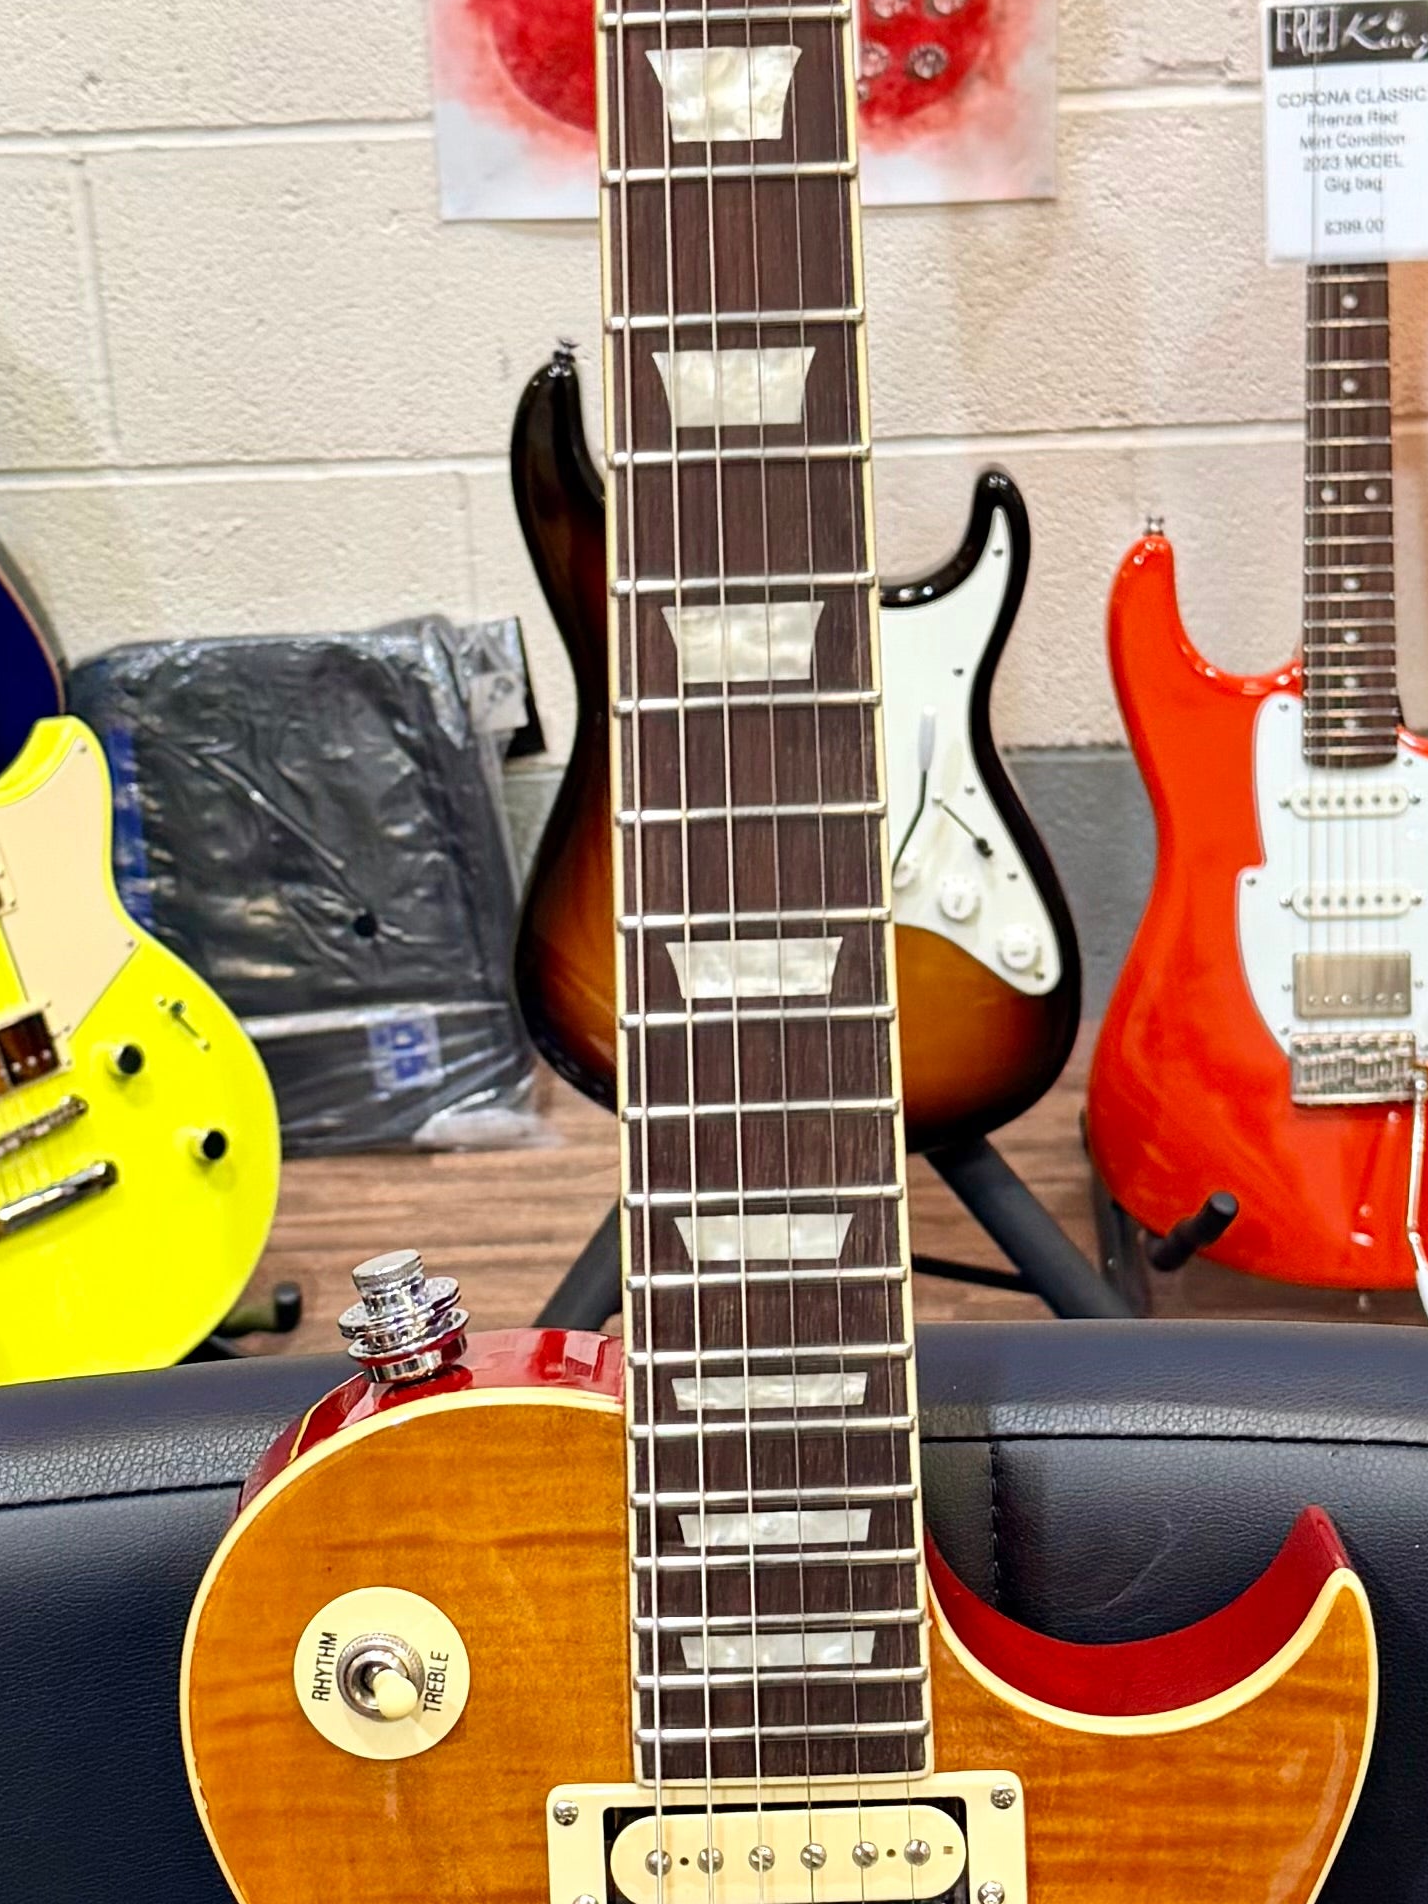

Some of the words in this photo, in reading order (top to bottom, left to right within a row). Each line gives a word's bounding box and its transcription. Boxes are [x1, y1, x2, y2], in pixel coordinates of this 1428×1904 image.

[1276, 6, 1341, 57] FRET
[1277, 90, 1351, 109] CORONA
[1355, 86, 1427, 105] CLASSIC
[1367, 110, 1398, 126] Red
[1299, 133, 1332, 151] Mint
[1335, 131, 1406, 149] Condition
[1344, 152, 1404, 169] MODEL
[1324, 175, 1352, 194] Gig
[1355, 174, 1383, 194] bag
[311, 1631, 338, 1702] RHYTHM
[422, 1650, 450, 1713] TREBLE
